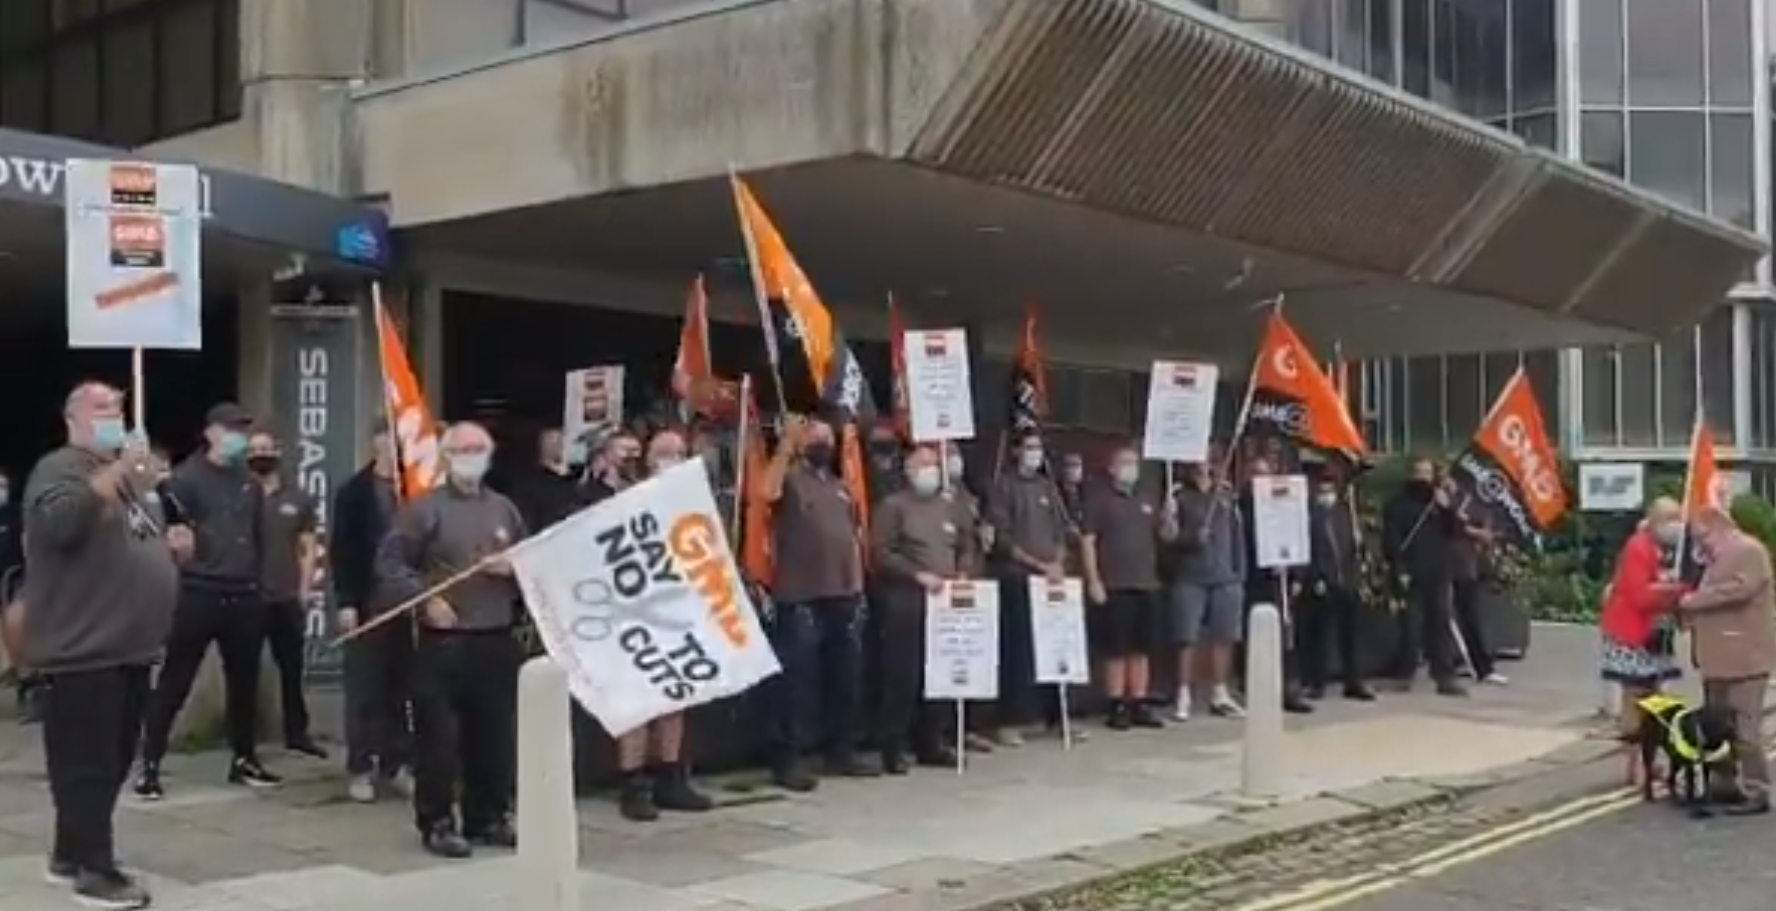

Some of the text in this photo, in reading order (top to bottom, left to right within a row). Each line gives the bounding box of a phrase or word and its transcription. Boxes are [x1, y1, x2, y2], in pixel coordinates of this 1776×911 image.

[297, 348, 327, 637] SEBASTI'S
[594, 525, 646, 597] NO
[631, 512, 682, 582] SAY
[619, 626, 695, 701] CUTS
[668, 631, 719, 682] TO
